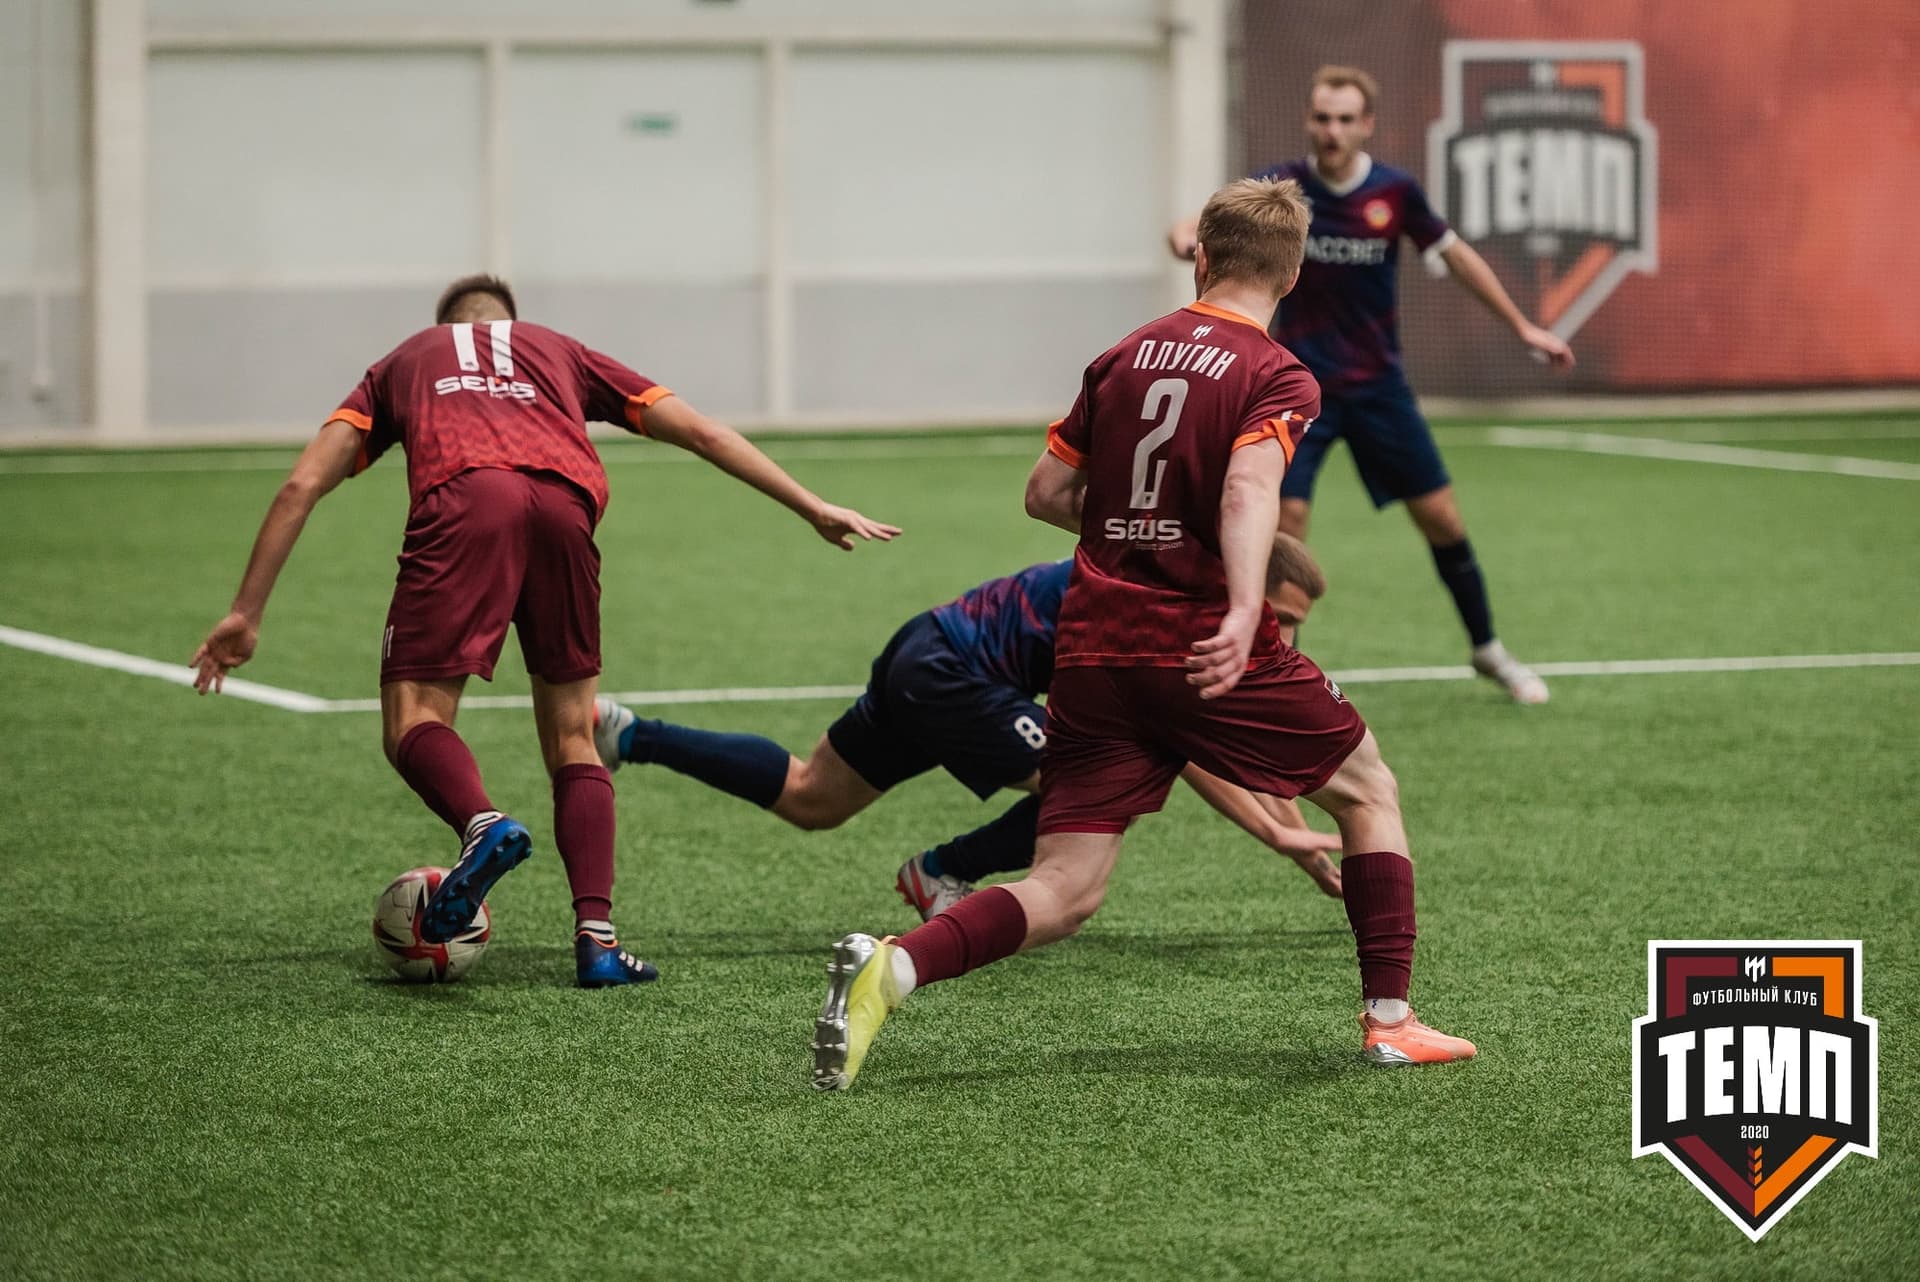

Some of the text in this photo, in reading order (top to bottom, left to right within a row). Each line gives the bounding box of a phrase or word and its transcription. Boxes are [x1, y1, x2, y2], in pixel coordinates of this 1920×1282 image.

[1452, 128, 1636, 240] ТЕМП
[1305, 235, 1388, 264] АССВЕТ
[452, 319, 515, 376] 11
[1132, 340, 1237, 380] ПЛУГИН
[435, 375, 536, 399] SEUS
[1129, 378, 1189, 509] 2
[1104, 518, 1182, 541] SEUS
[1014, 715, 1047, 750] 8
